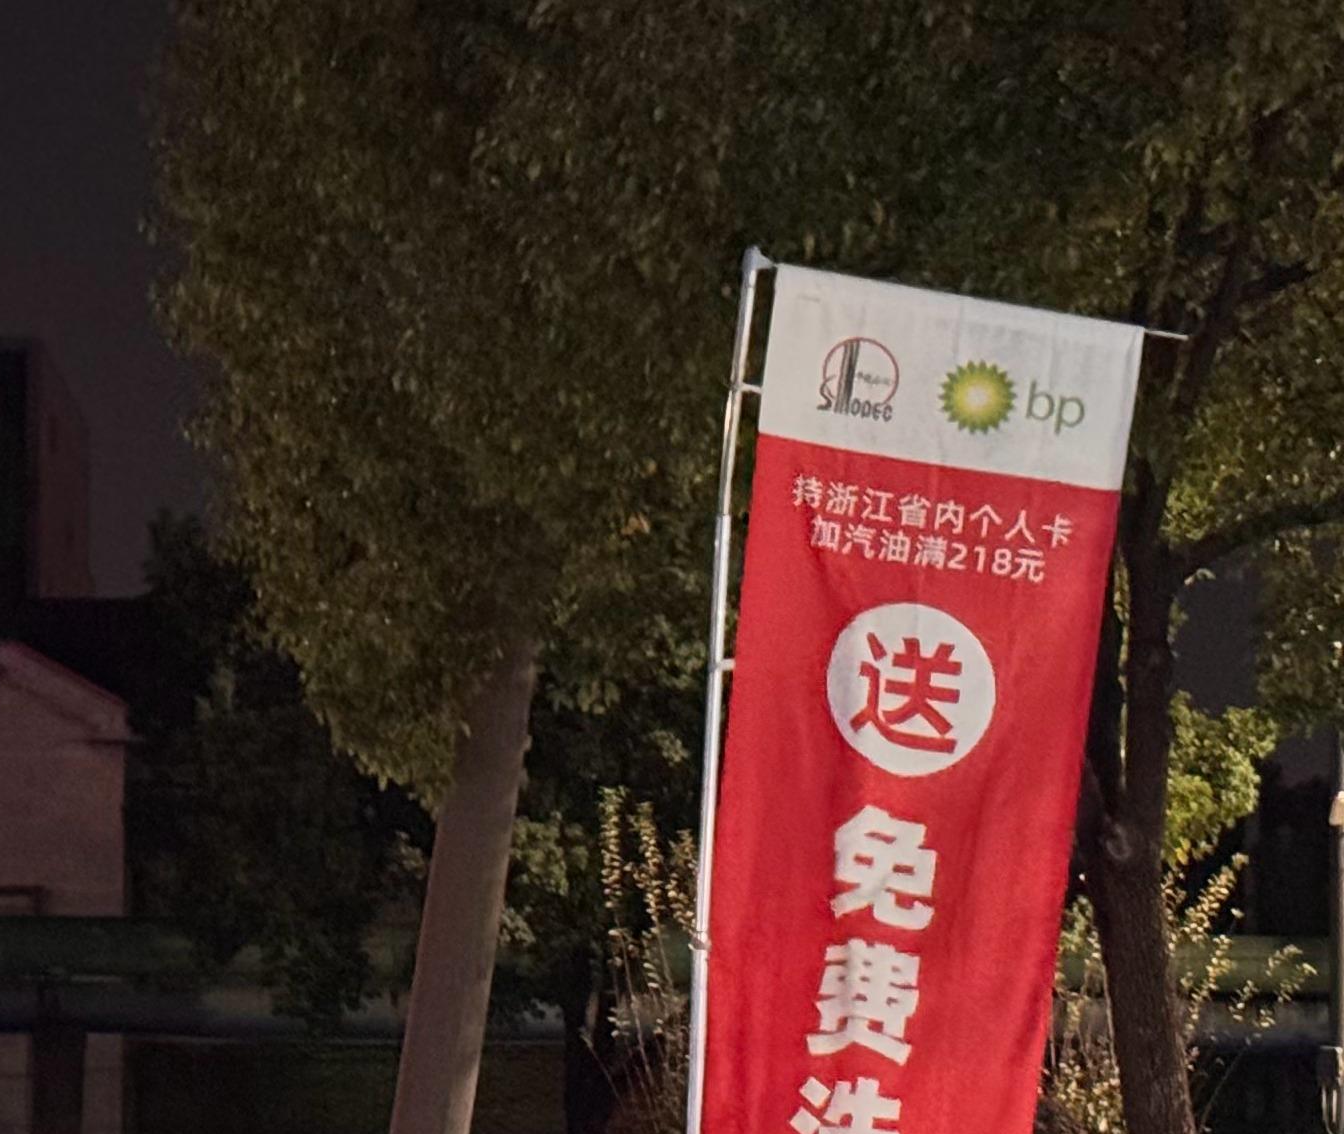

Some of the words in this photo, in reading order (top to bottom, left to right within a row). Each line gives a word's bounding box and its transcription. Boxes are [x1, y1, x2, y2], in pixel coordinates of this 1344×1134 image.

[1025, 380, 1086, 435] bp
[792, 474, 1075, 549] 持浙江省内个人卡
[810, 514, 1046, 584] 加汽油满218元
[849, 631, 963, 754] 送
